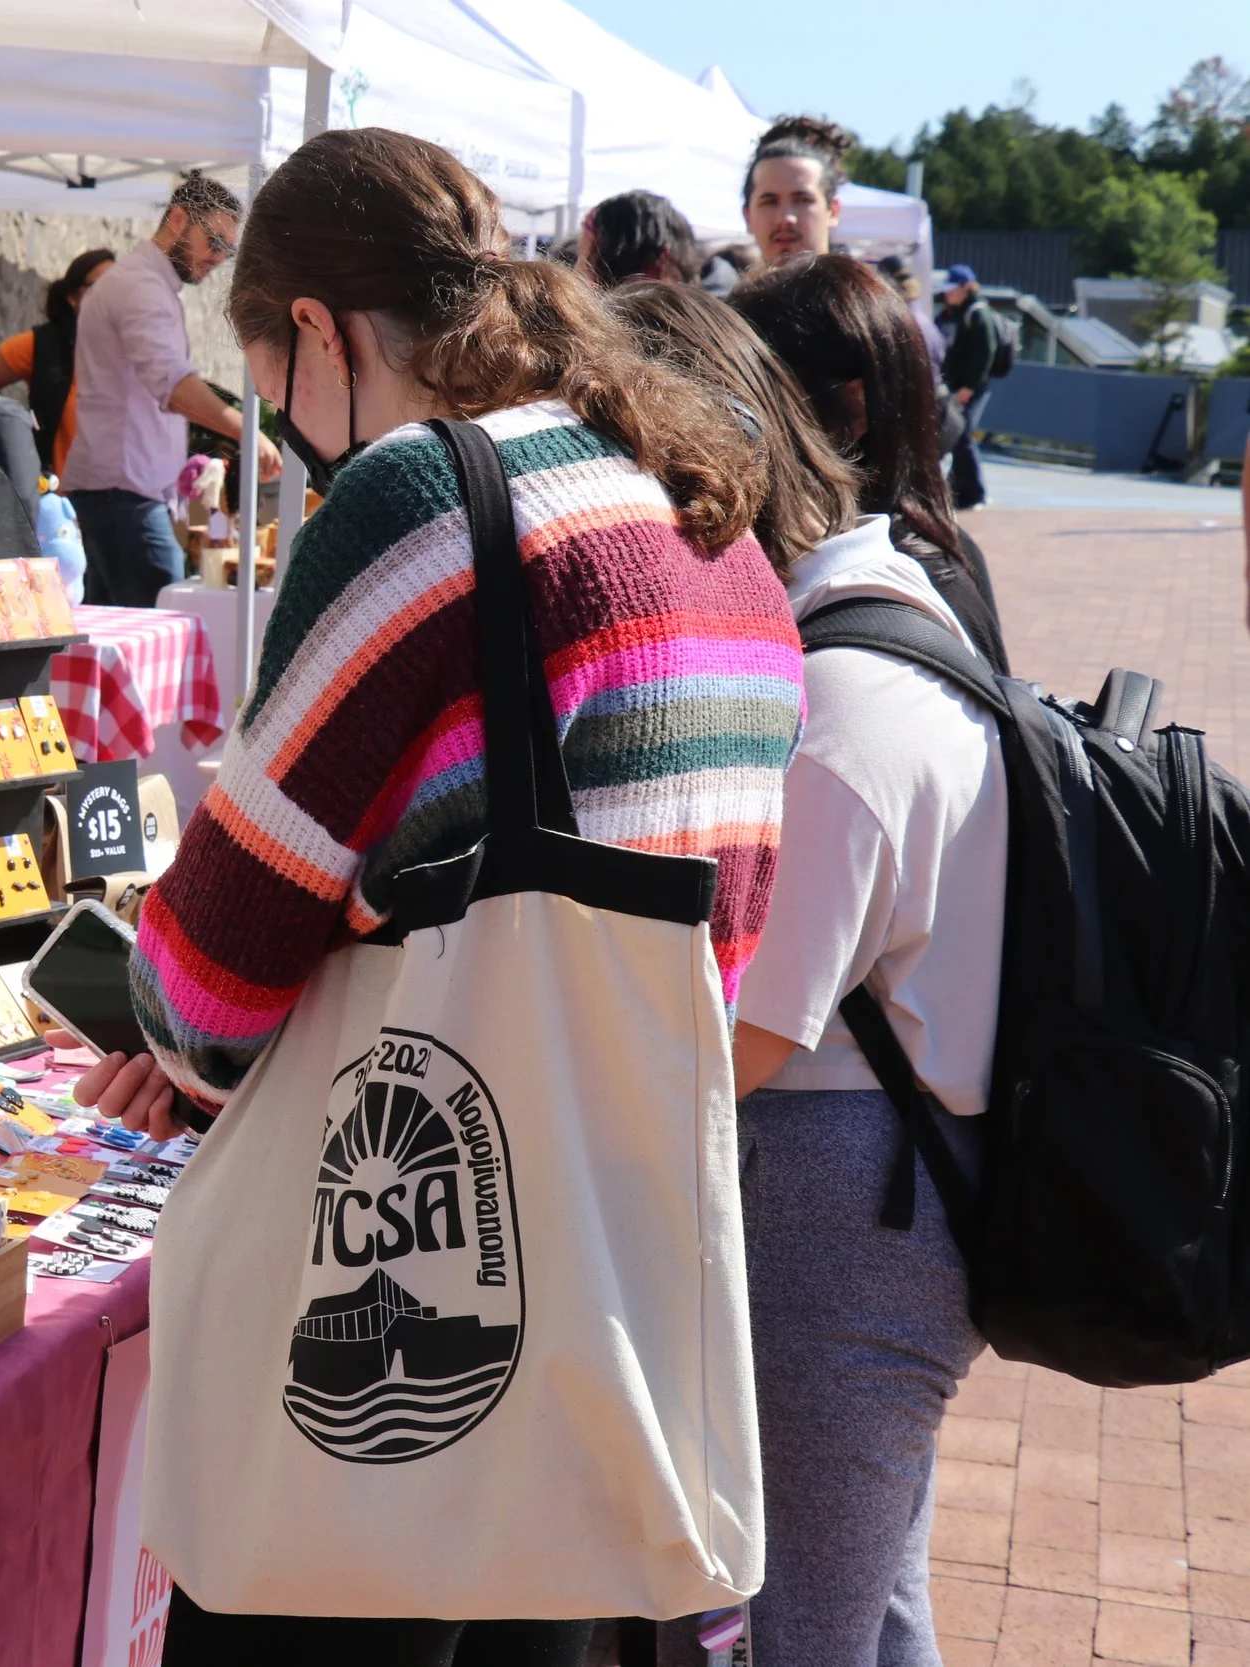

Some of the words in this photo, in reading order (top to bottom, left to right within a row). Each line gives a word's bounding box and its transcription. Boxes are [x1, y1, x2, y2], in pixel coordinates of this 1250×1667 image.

[78, 785, 110, 820] MYSTERY
[110, 788, 130, 814] BAGS
[88, 808, 122, 841] $15
[103, 844, 126, 855] VALUE
[445, 1081, 507, 1287] Nogojiwanong
[311, 1170, 466, 1268] TCSA
